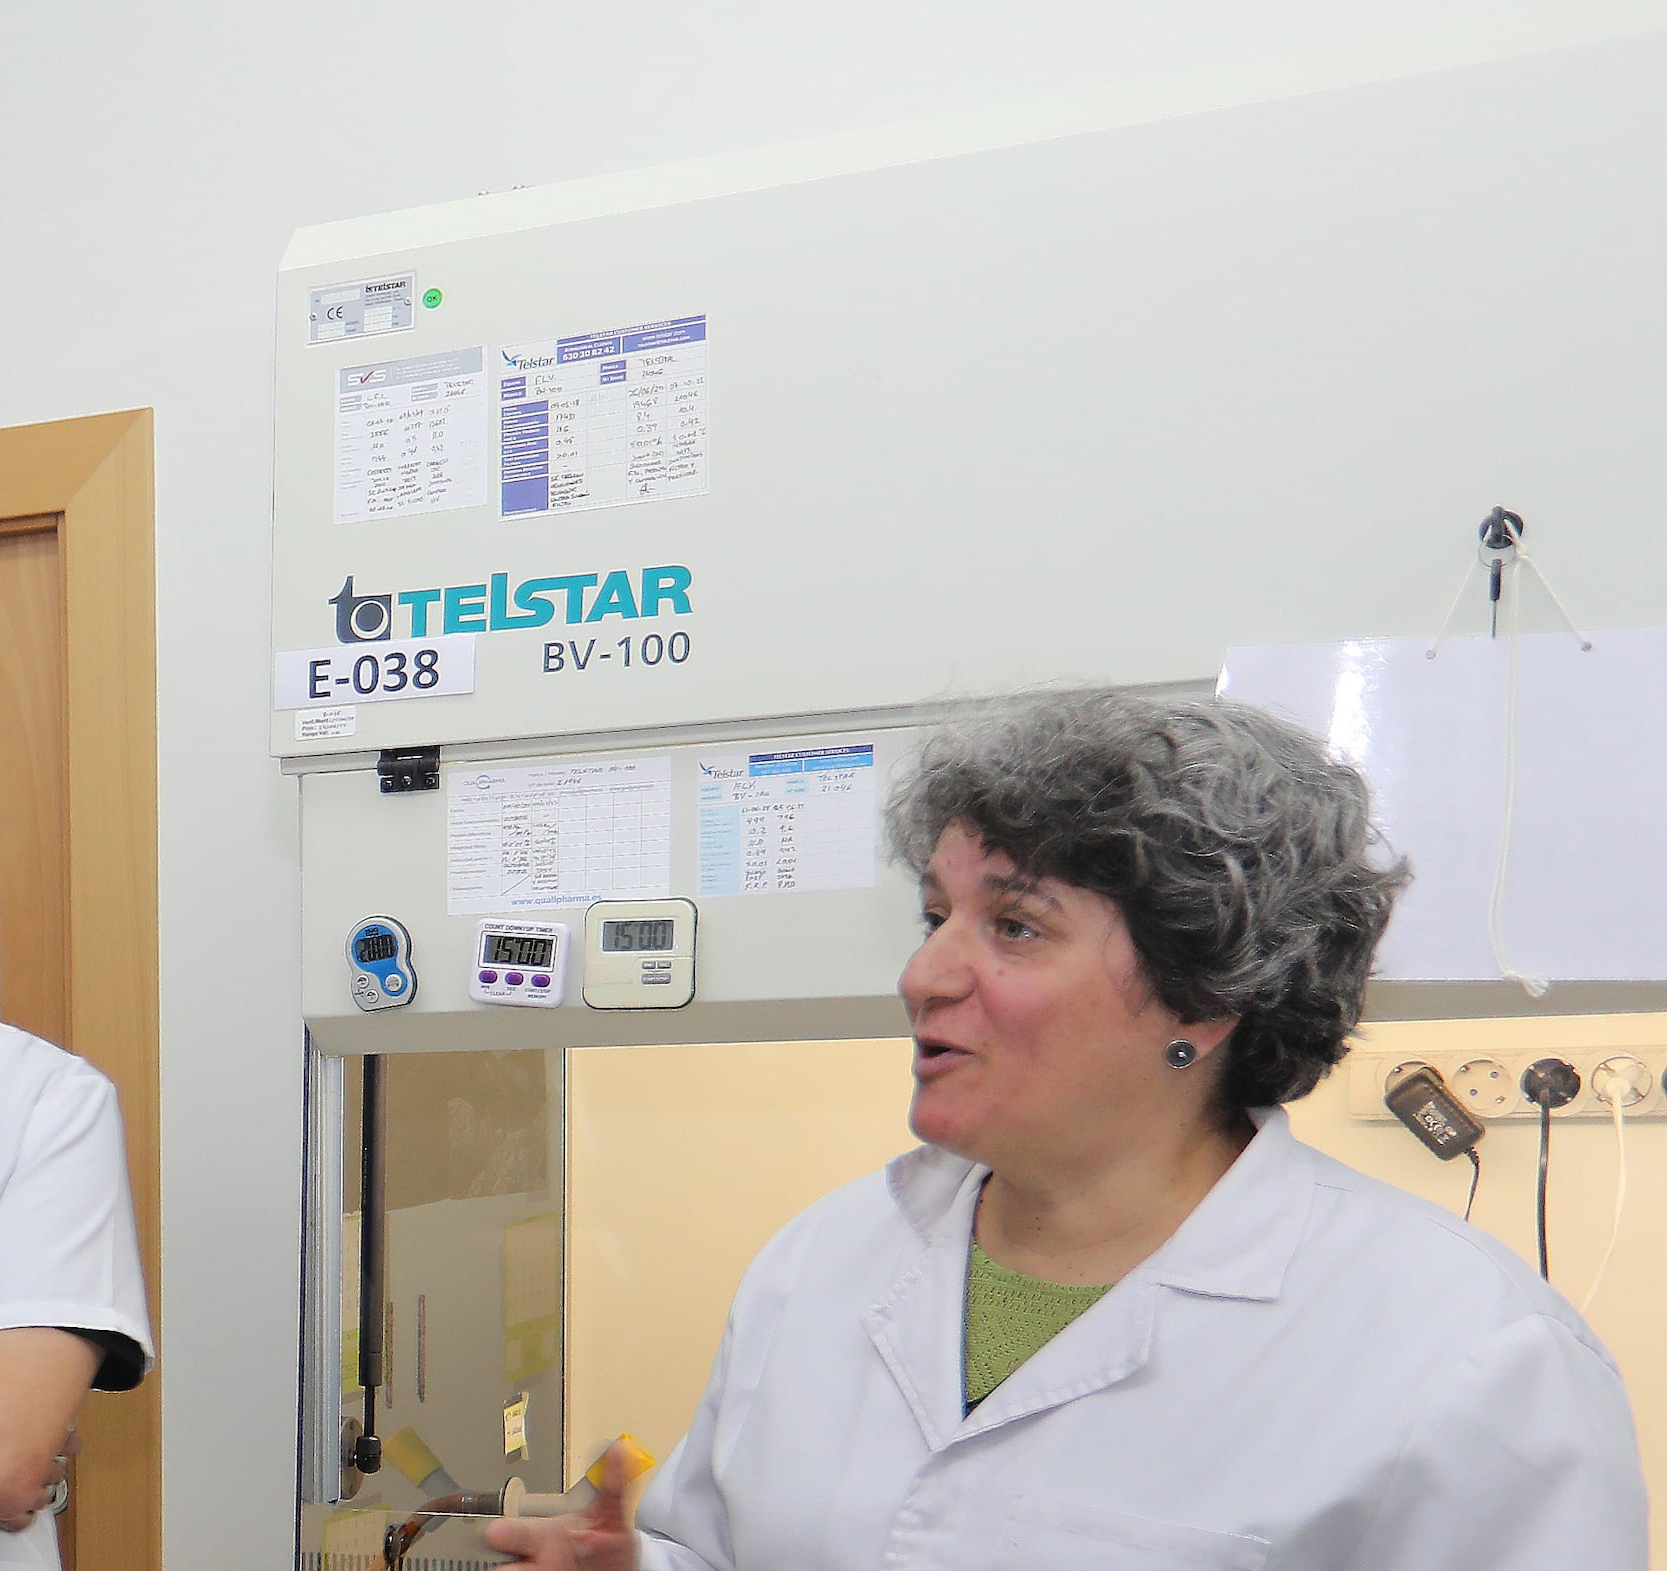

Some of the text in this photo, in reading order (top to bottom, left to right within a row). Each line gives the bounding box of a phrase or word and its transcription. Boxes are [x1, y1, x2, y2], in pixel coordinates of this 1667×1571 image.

[372, 281, 406, 292] TELSTAR
[327, 306, 343, 320] CE
[563, 351, 579, 361] 630
[579, 350, 591, 359] 30
[603, 346, 615, 354] 42
[516, 354, 555, 371] Telstar
[398, 565, 693, 637] TELSTAR
[543, 630, 691, 674] BV-100
[308, 648, 441, 698] E-038
[713, 768, 744, 780] Telstar
[511, 893, 602, 906] www.qualipharma.es
